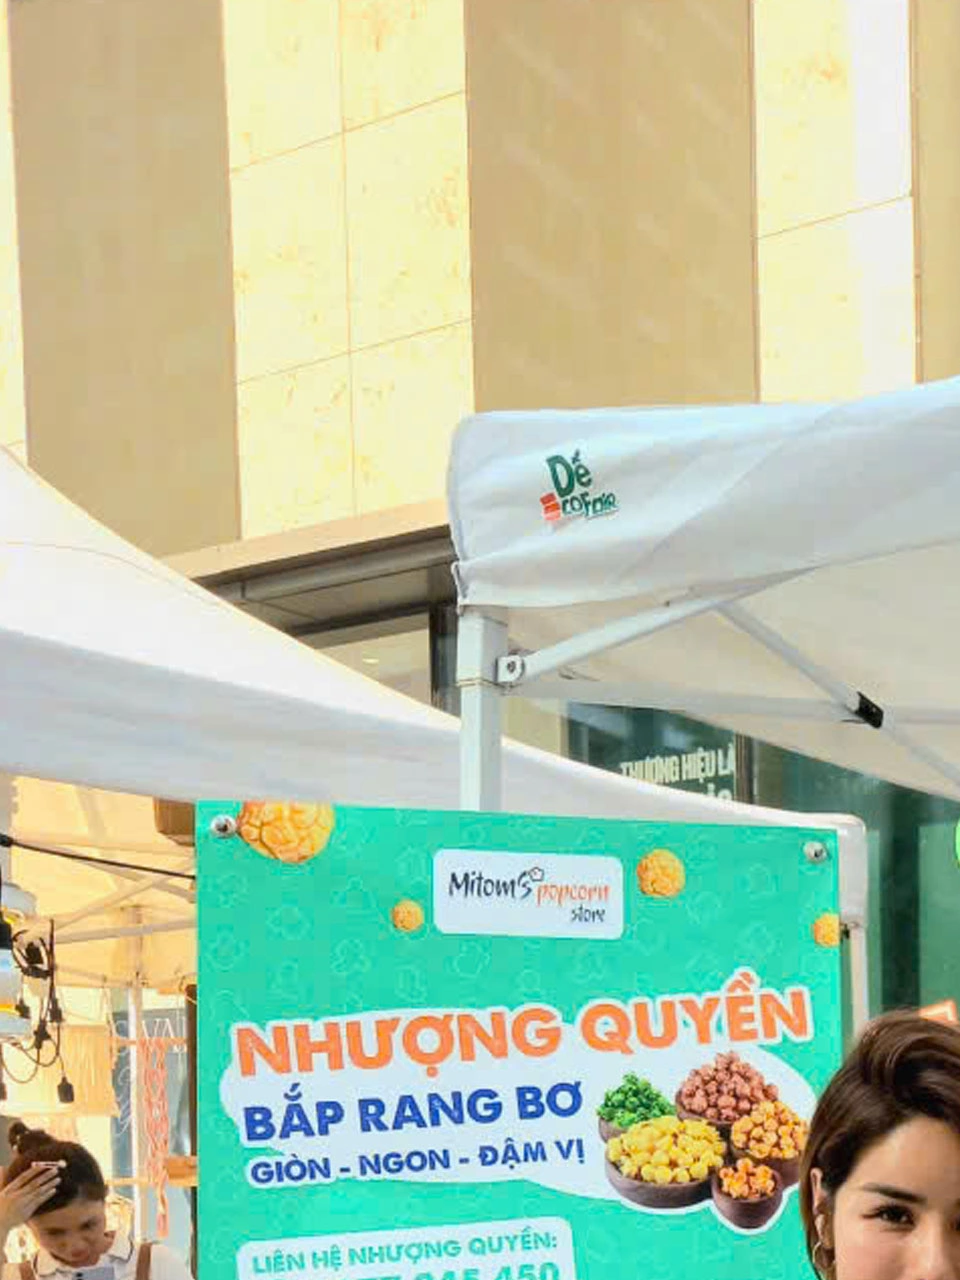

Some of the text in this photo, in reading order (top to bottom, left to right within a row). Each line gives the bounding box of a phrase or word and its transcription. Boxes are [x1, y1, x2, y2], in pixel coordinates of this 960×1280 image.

[536, 884, 611, 907] popcorn
[570, 903, 606, 923] store
[236, 1006, 563, 1078] NHƯỢNG
[579, 971, 810, 1054] QUYỀN
[243, 1080, 584, 1142] BẮP RANG BƠ
[250, 1155, 332, 1185] GIÒN
[358, 1149, 451, 1179] NGON
[478, 1138, 548, 1169] ĐẬM
[556, 1138, 587, 1166] VỊ
[252, 1250, 306, 1275] LIÊN
[311, 1244, 343, 1272] HỆ
[349, 1239, 462, 1266] NHƯỢNG
